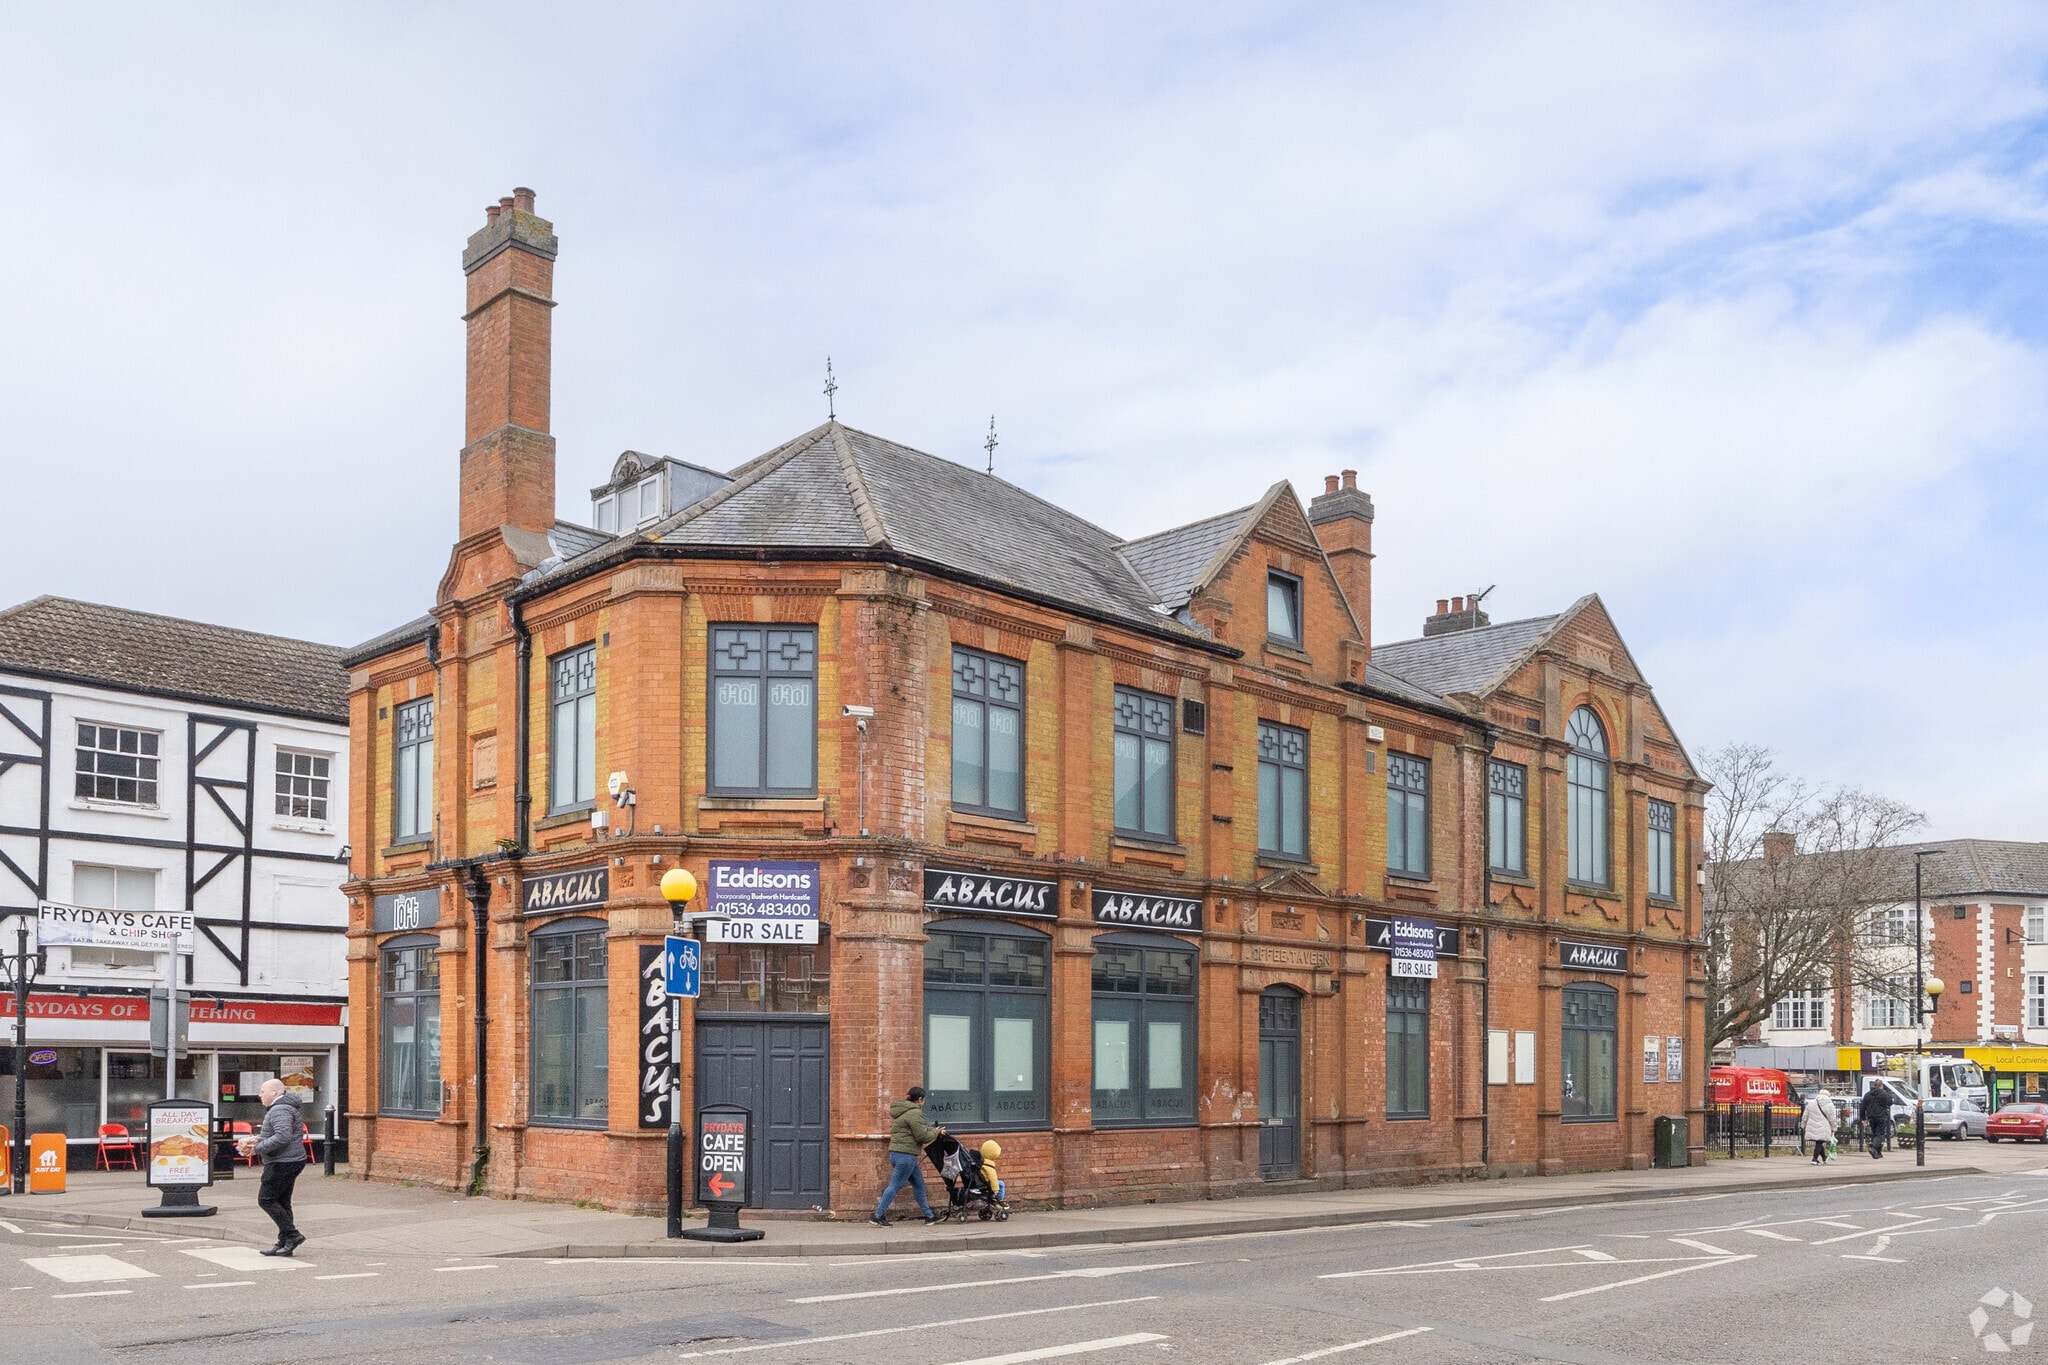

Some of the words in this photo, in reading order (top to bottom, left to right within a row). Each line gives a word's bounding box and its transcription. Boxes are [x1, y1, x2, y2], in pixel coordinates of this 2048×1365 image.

[716, 866, 811, 889] Eddisons
[527, 871, 604, 909] ABACUS
[716, 892, 751, 901] Incorporating
[779, 893, 811, 901] Hardcastle
[933, 875, 1050, 911] ABACUS
[40, 906, 135, 926] FRYDAYS
[141, 914, 192, 930] CAFE
[394, 896, 419, 930] loft
[716, 902, 755, 916] 01536
[757, 903, 811, 916] 483400
[1100, 895, 1196, 926] ABACUS
[109, 927, 117, 936] &
[121, 928, 147, 938] CHIP
[721, 922, 754, 939] FOR
[761, 923, 804, 940] SALE
[1394, 920, 1434, 940] Eddisons
[1569, 945, 1619, 967] ABACUS
[1398, 962, 1413, 975] FOR
[1414, 963, 1432, 975] SALE
[5, 998, 104, 1016] FRYDAYS
[110, 1003, 138, 1016] OF
[190, 1006, 256, 1020] TERING
[642, 950, 672, 1122] ABACUS
[30, 1053, 56, 1062] OPEN
[1996, 1056, 2015, 1064] Local
[703, 1123, 745, 1133] FRYDAYS
[703, 1133, 744, 1151] CAFE
[702, 1155, 744, 1172] OPEN
